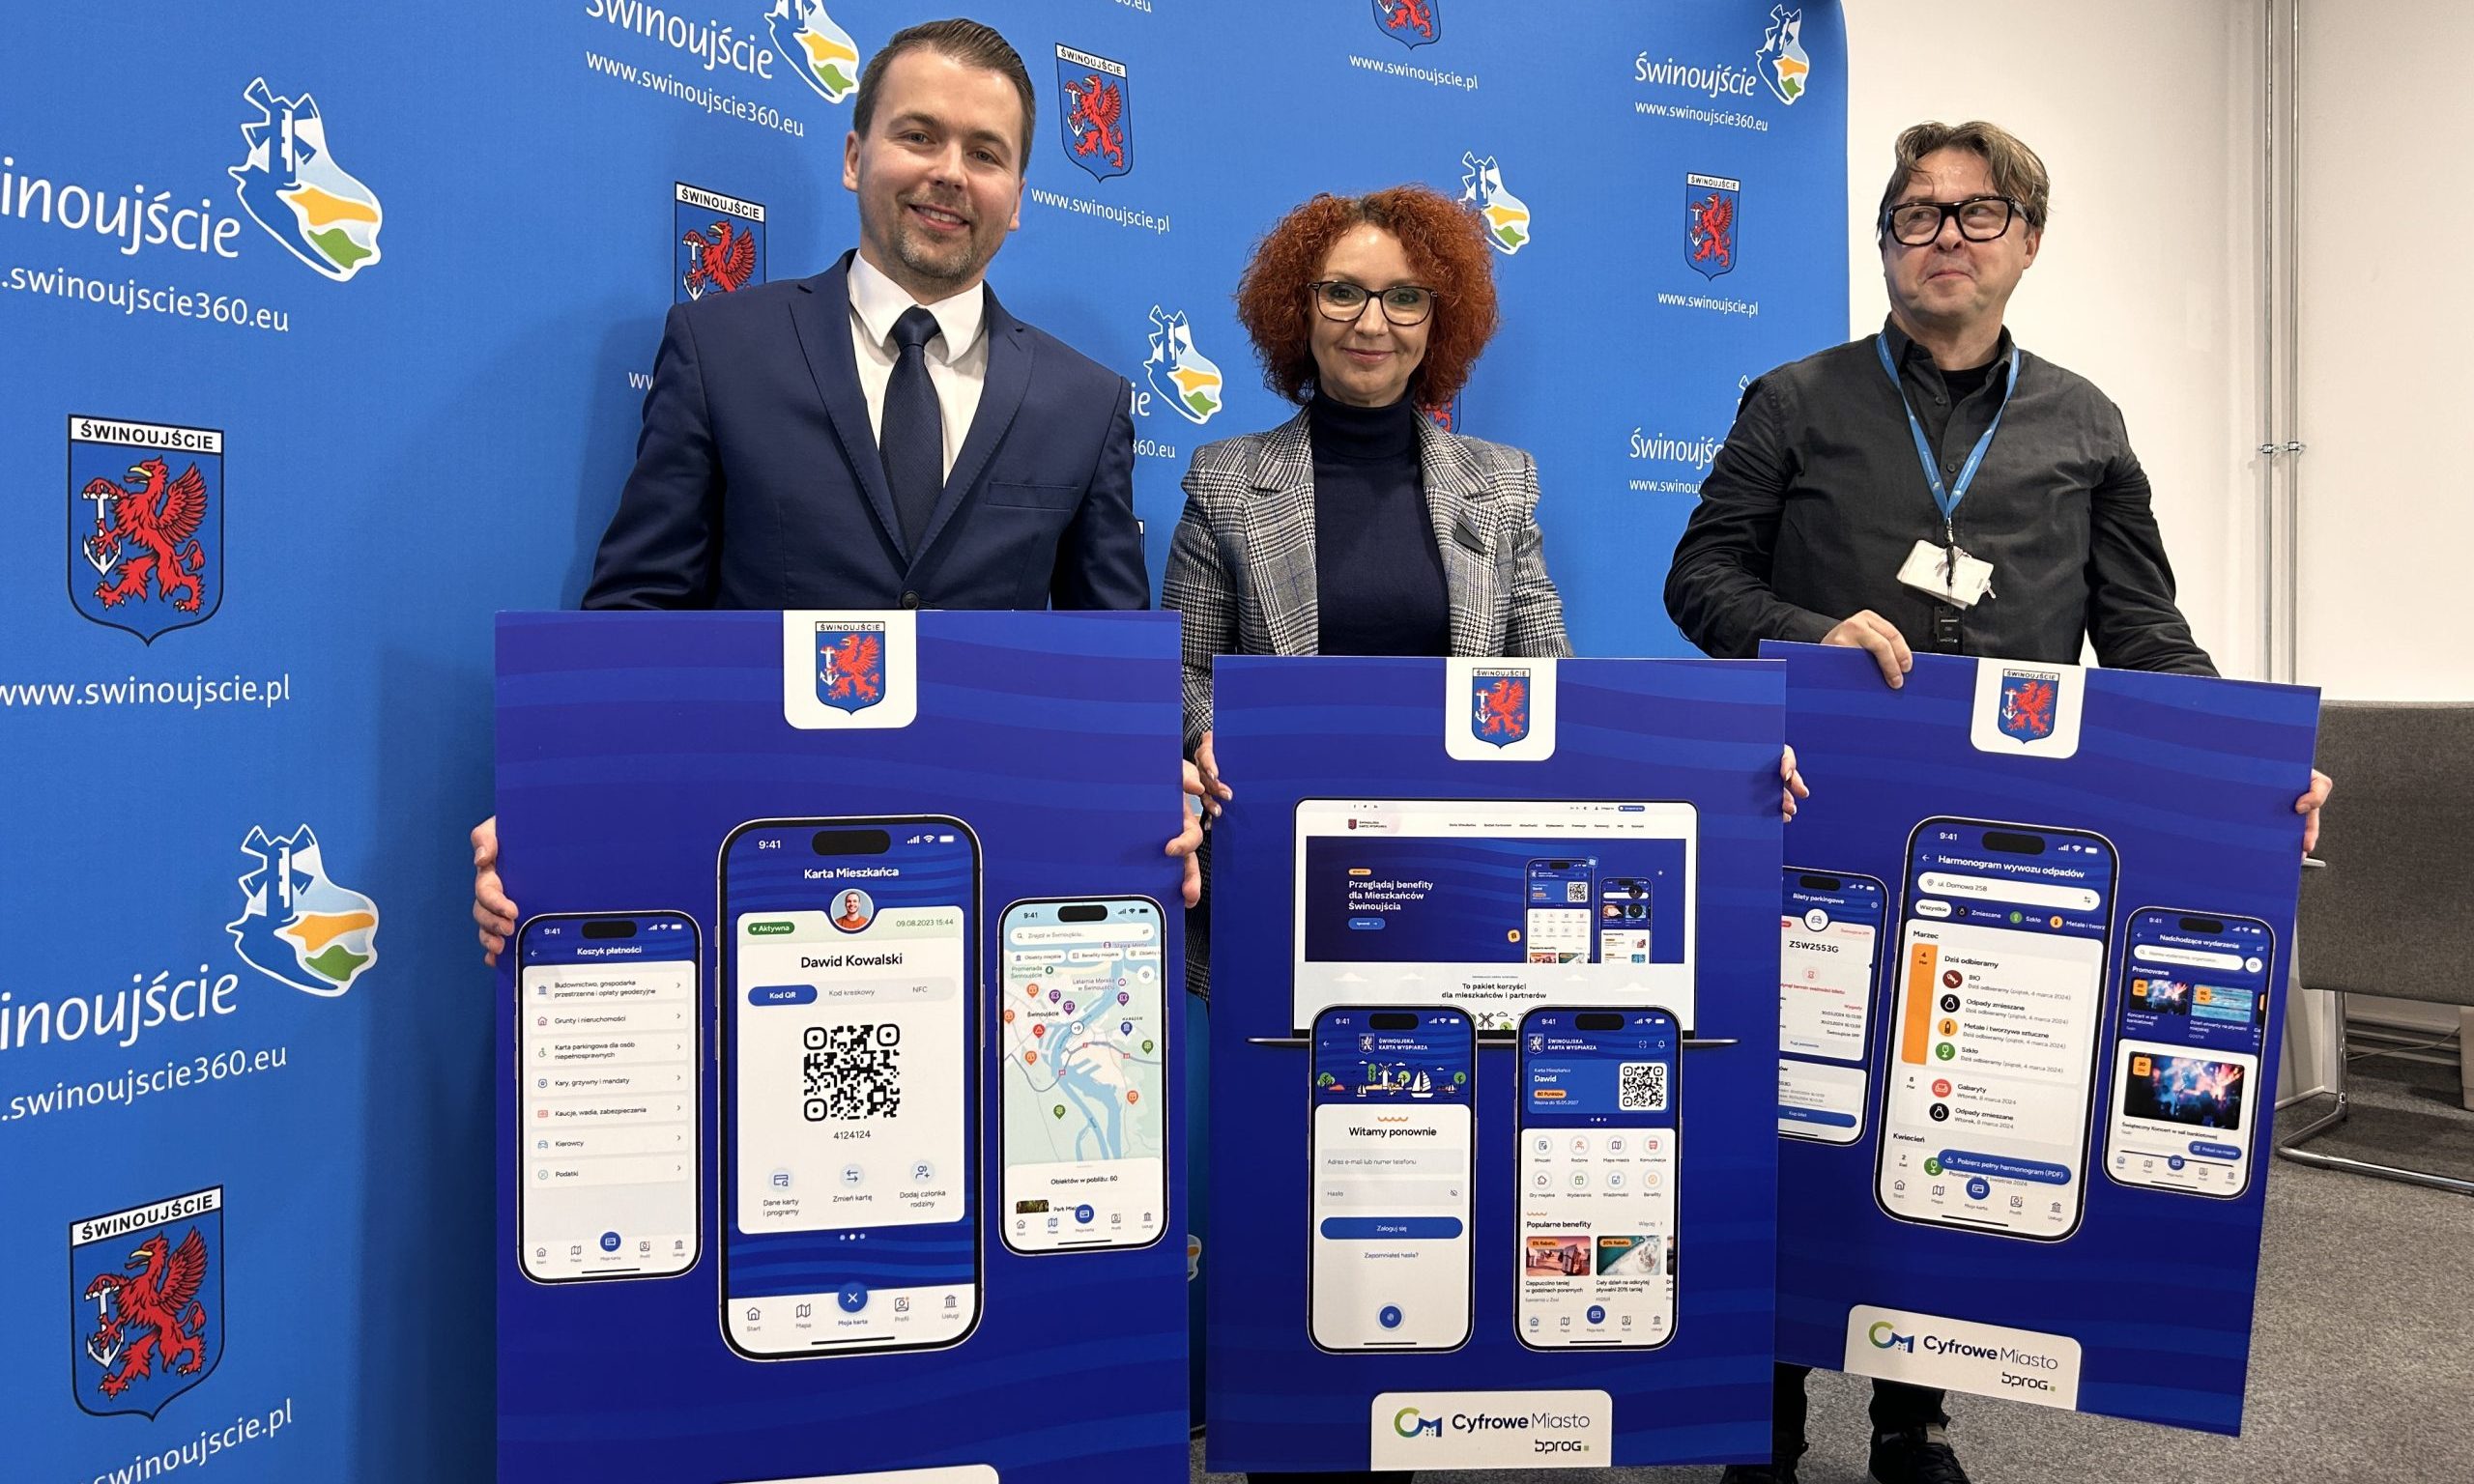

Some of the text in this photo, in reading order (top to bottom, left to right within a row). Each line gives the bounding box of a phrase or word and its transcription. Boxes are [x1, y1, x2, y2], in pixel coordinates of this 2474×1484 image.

[1061, 48, 1122, 74] ŚWINOUJŚCIE
[1349, 54, 1479, 91] www.swinoujscie.pl
[1635, 51, 1757, 98] Świnoujście
[586, 50, 804, 137] www.swinoujscie360.eu
[1635, 101, 1769, 131] www.swinoujscie360.eu
[1691, 176, 1737, 189] ŚWINOUJŚCIE
[681, 187, 760, 218] ŚWINOUJŚCIE
[1031, 188, 1169, 235] www.swinoujscie.pl
[1658, 293, 1759, 318] www.swinoujscie.pl
[80, 421, 214, 450] ŚWINOUJŚCIE
[1940, 832, 1958, 841] 9:41
[759, 840, 781, 849] 9:41
[1938, 855, 2085, 878] Harmonogram wywozu odpadów
[804, 867, 899, 879] Karta Mieszkańca
[1349, 880, 1433, 890] Przeglądaj benefity
[1349, 891, 1424, 899] dla Mieszkańców
[1349, 901, 1401, 911] Świnoujścia
[1919, 903, 1947, 913] Wszystkie
[1971, 909, 2001, 919] Zmieszane
[896, 918, 954, 928] 09.08.2023 15:44
[544, 927, 561, 936] 9:41
[759, 924, 790, 933] Aktywna
[1913, 929, 1939, 939] Marzec
[2159, 934, 2201, 945] Nadchodzące
[577, 944, 642, 956] Koszyk płatności
[1789, 940, 1839, 954] ZSW2553G
[801, 953, 903, 968] Dawid Kowalski
[1961, 957, 1999, 968] odbieramy
[2132, 966, 2170, 976] Promowane
[844, 987, 875, 997] kreskowy
[1497, 983, 1527, 991] korzyści
[1509, 991, 1546, 1000] partnerów
[1967, 998, 2025, 1012] Odpady zmieszane
[555, 1016, 577, 1026] Grunty
[572, 1042, 607, 1052] parkingowa
[603, 1076, 630, 1086] mandaty
[1957, 1084, 1987, 1094] Gabaryty
[1955, 1107, 2014, 1121] Odpady zmieszane
[834, 1130, 871, 1140] 4124124
[1349, 1127, 1437, 1138] Witamy ponownie
[1893, 1132, 1925, 1143] Kwiecień
[555, 1139, 585, 1149] Kierowcy
[1957, 1156, 2064, 1179] Pobierz pełny harmonogram (PDF)
[555, 1169, 579, 1178] Podatki
[833, 1193, 873, 1203] Zmień kartę
[900, 1189, 946, 1199] Dodaj członka
[782, 1197, 799, 1207] karty
[910, 1199, 935, 1209] rodziny
[80, 1194, 214, 1241] ŚWINOUJŚCIE
[766, 1208, 799, 1217] programy
[1562, 1220, 1592, 1229] benefity
[1923, 1335, 2058, 1370] Cyfrowe Miasto
[1452, 1413, 1590, 1434] Cyfrowe Miasto
